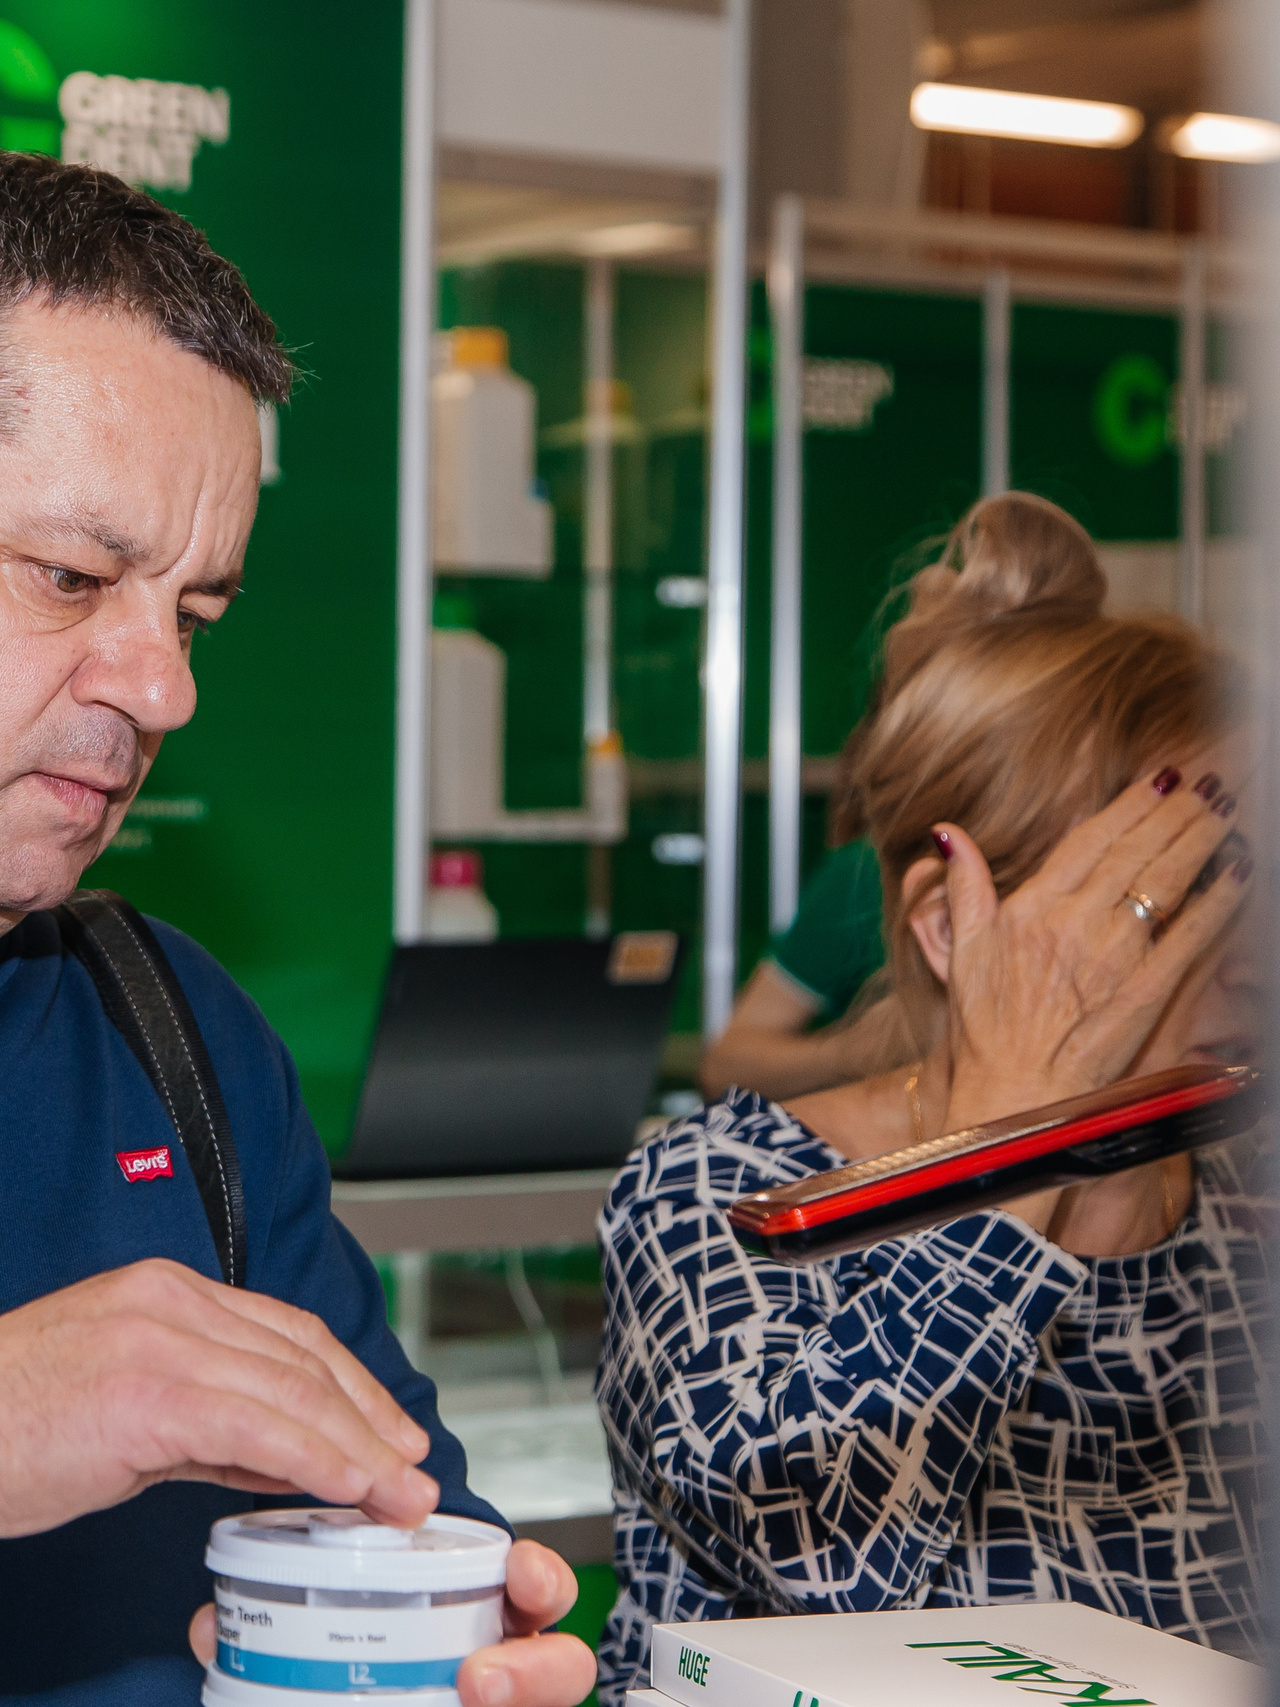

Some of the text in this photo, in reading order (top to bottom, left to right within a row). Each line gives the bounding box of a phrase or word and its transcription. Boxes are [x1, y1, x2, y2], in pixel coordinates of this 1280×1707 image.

[58, 71, 230, 146] GREEN
[237, 1607, 273, 1627] Teeth
[348, 1663, 377, 1685] L2
[678, 1645, 711, 1687] HUGE
[904, 1640, 1158, 1707] KAILI
